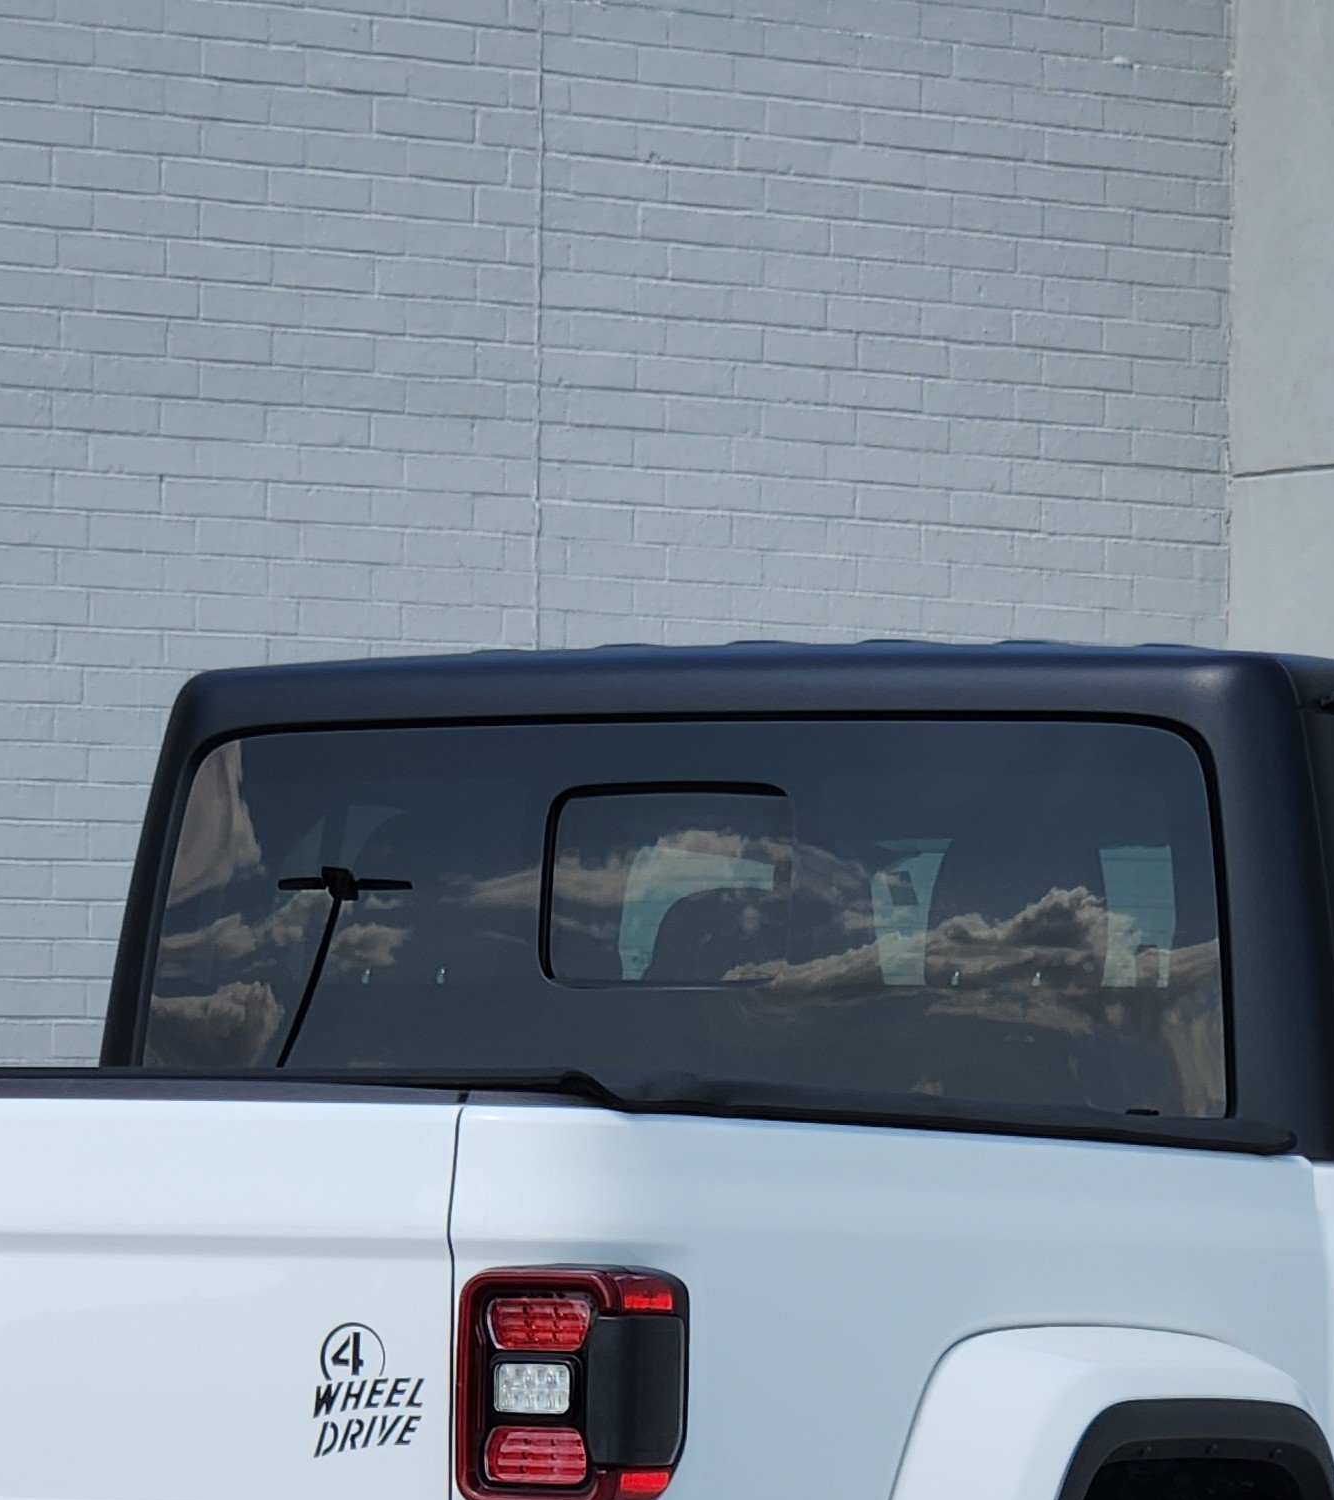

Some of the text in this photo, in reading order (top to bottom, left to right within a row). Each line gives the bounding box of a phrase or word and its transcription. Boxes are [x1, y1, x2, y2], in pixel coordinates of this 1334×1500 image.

[331, 1332, 364, 1376] 4
[313, 1378, 424, 1419] WHEEL
[313, 1415, 423, 1458] DRIVE
